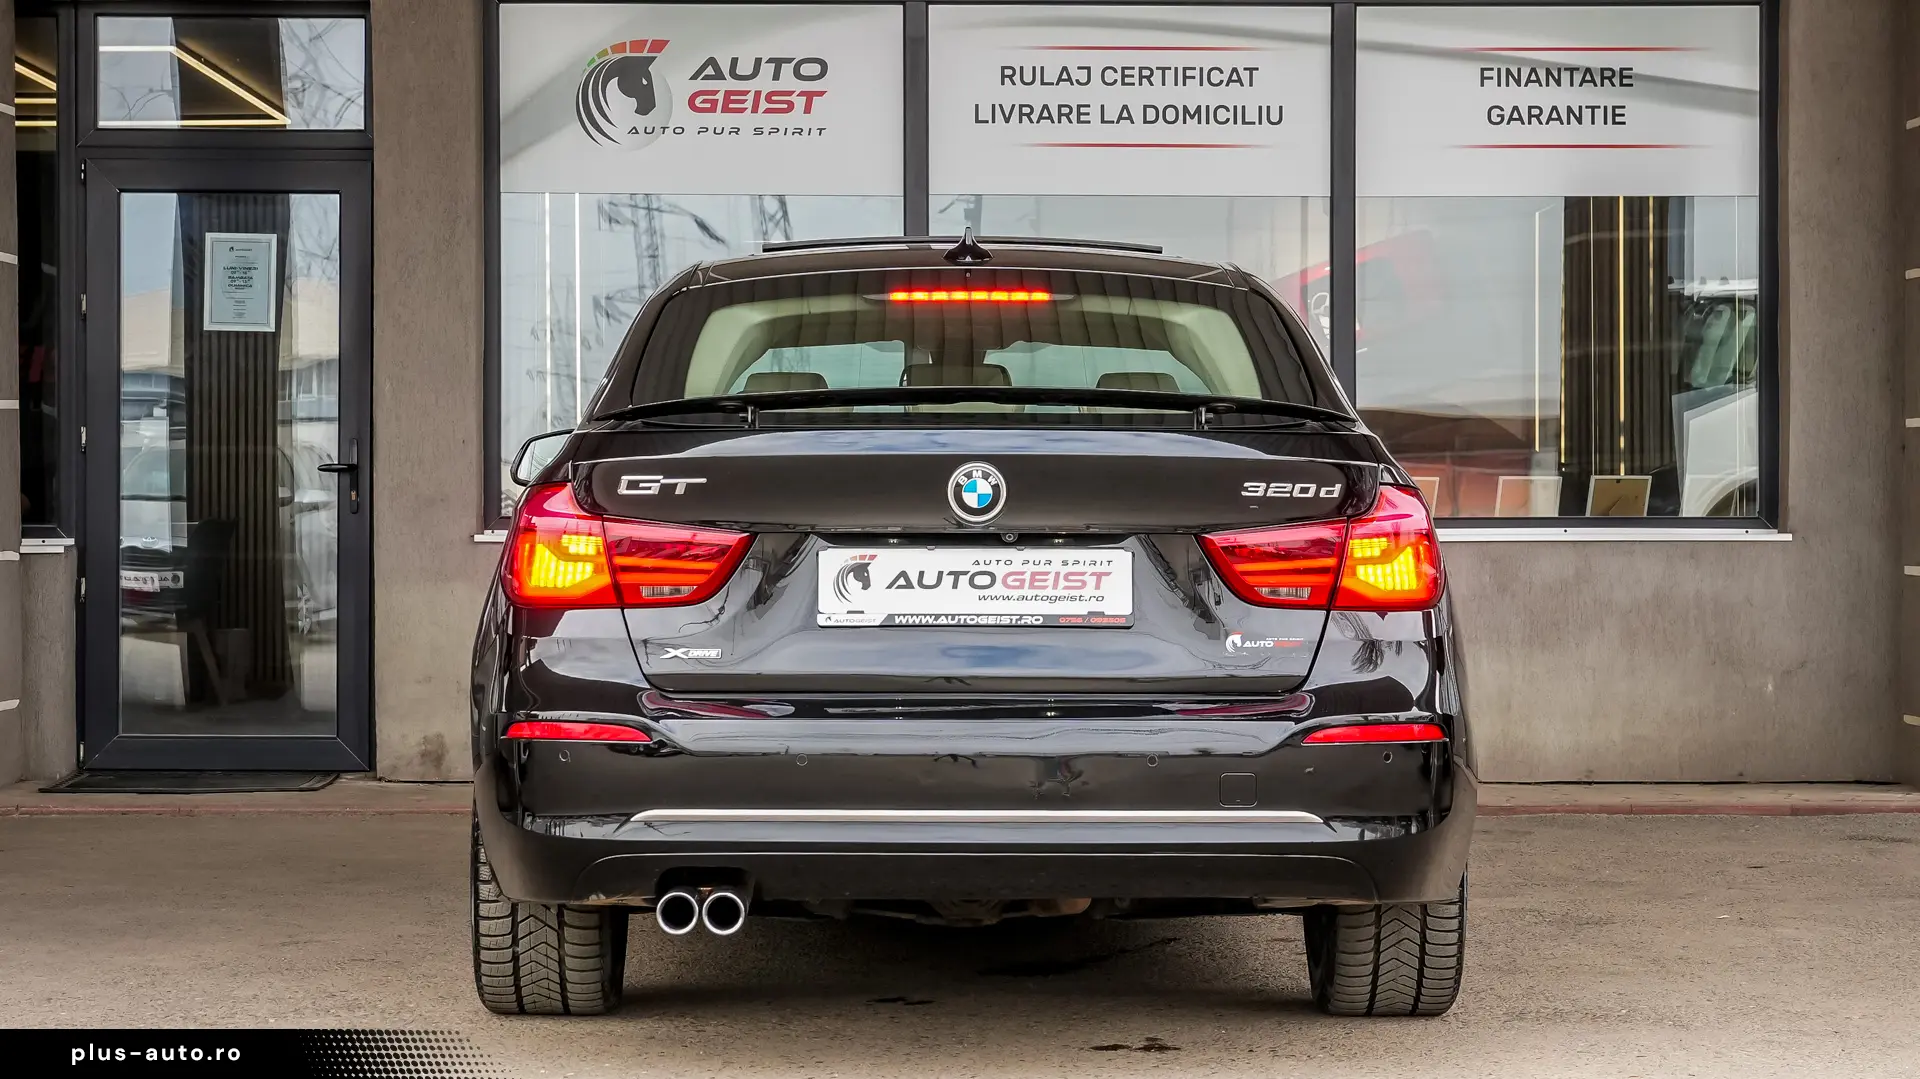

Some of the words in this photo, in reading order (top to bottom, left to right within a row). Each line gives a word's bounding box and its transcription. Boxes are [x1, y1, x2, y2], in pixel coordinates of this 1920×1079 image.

[688, 56, 829, 82] AUTO
[1000, 66, 1092, 86] RULAJ
[1100, 66, 1259, 87] CERTIFICAT
[1479, 67, 1634, 88] FINANTARE
[687, 89, 828, 115] GEIST
[974, 103, 1091, 124] LIVRARE
[1099, 104, 1135, 125] LA
[1142, 104, 1284, 126] DOMICILIU
[1487, 105, 1627, 126] GARANTIE
[627, 126, 685, 135] AUTO
[697, 126, 741, 136] PUR
[752, 126, 827, 137] SPIRIT
[617, 475, 707, 495] GT
[958, 469, 998, 486] BMW
[978, 593, 1105, 604] www.autogeist.ro
[894, 615, 1044, 625] WWW.AUTOGEIST.RO
